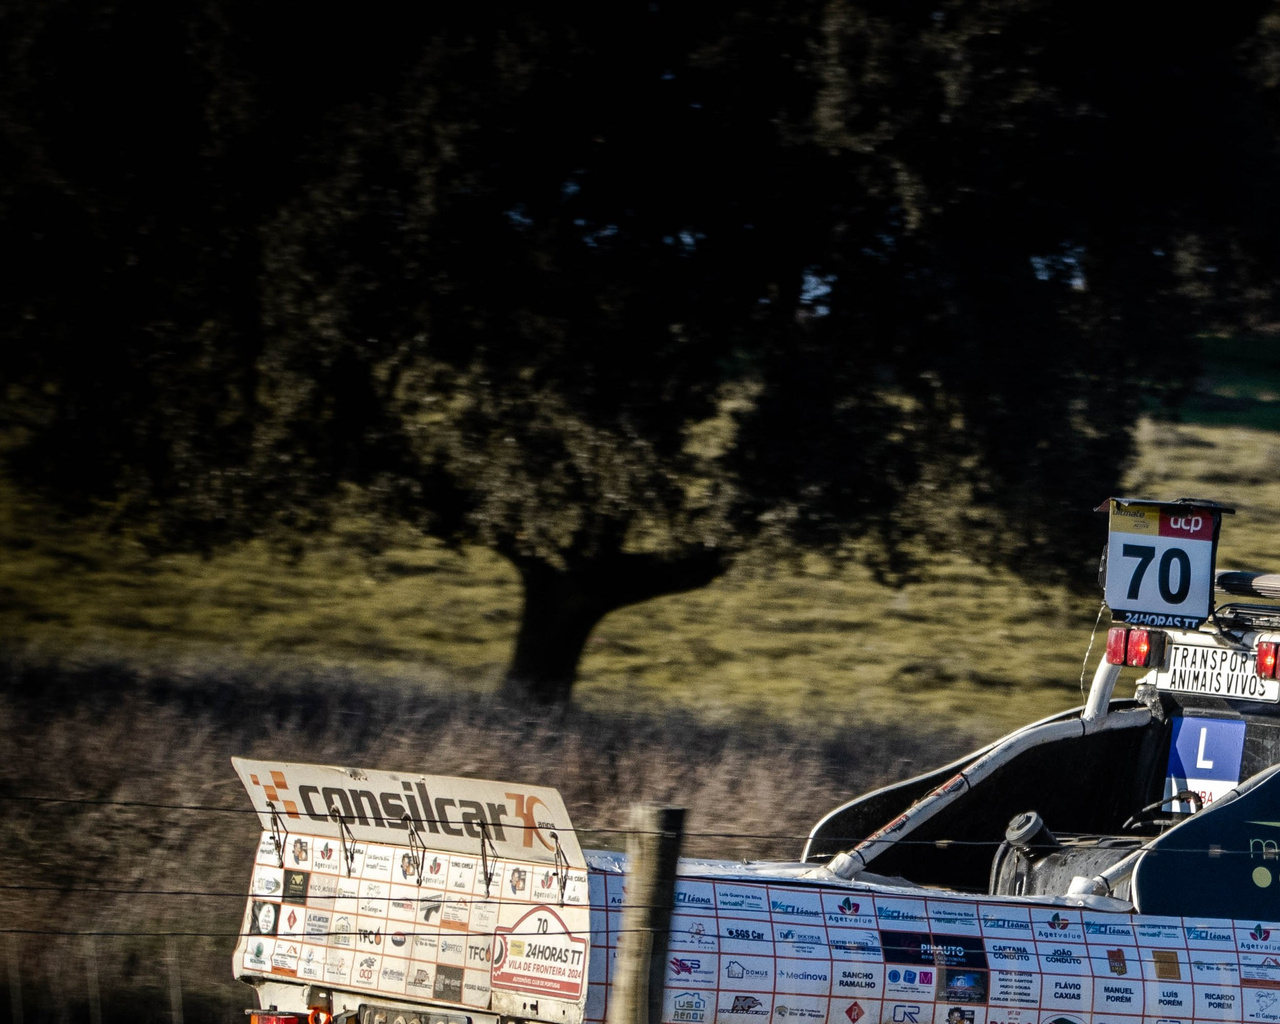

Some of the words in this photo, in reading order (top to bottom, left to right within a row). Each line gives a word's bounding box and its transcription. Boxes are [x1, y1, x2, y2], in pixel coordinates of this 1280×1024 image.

[1122, 543, 1191, 605] 70
[1183, 618, 1198, 629] TT
[1169, 668, 1221, 692] ANIMAIS
[1226, 673, 1266, 697] VIVOS
[1196, 727, 1214, 769] L
[299, 781, 508, 843] consilcar
[537, 918, 548, 934] 70
[751, 930, 764, 940] Car
[1209, 930, 1231, 941] Léana
[469, 944, 485, 961] TFC
[993, 945, 1028, 953] CAETANA
[1051, 948, 1072, 957] JOÃO
[526, 943, 569, 963] 24HORAS
[571, 950, 583, 966] TT
[993, 953, 1029, 962] CONDUTO
[1046, 956, 1081, 965] CONDUTO
[508, 960, 521, 970] VILA
[523, 962, 531, 972] DE
[532, 963, 566, 977] FRONTEIRA
[568, 969, 582, 979] 2024
[360, 968, 373, 982] acp
[786, 971, 828, 982] Medinova
[842, 971, 873, 980] SANCHO
[839, 980, 876, 989] RAMALHO
[1054, 981, 1082, 991] FLÁVIO
[1104, 986, 1134, 995] MANUEL
[1162, 990, 1179, 999] LUÍS
[1053, 992, 1081, 1001] CAXIAS
[1106, 994, 1132, 1003] PORÉM
[1204, 992, 1235, 1002] RICARDO
[1158, 998, 1183, 1007] PORÉM
[1261, 1013, 1279, 1021] Galego
